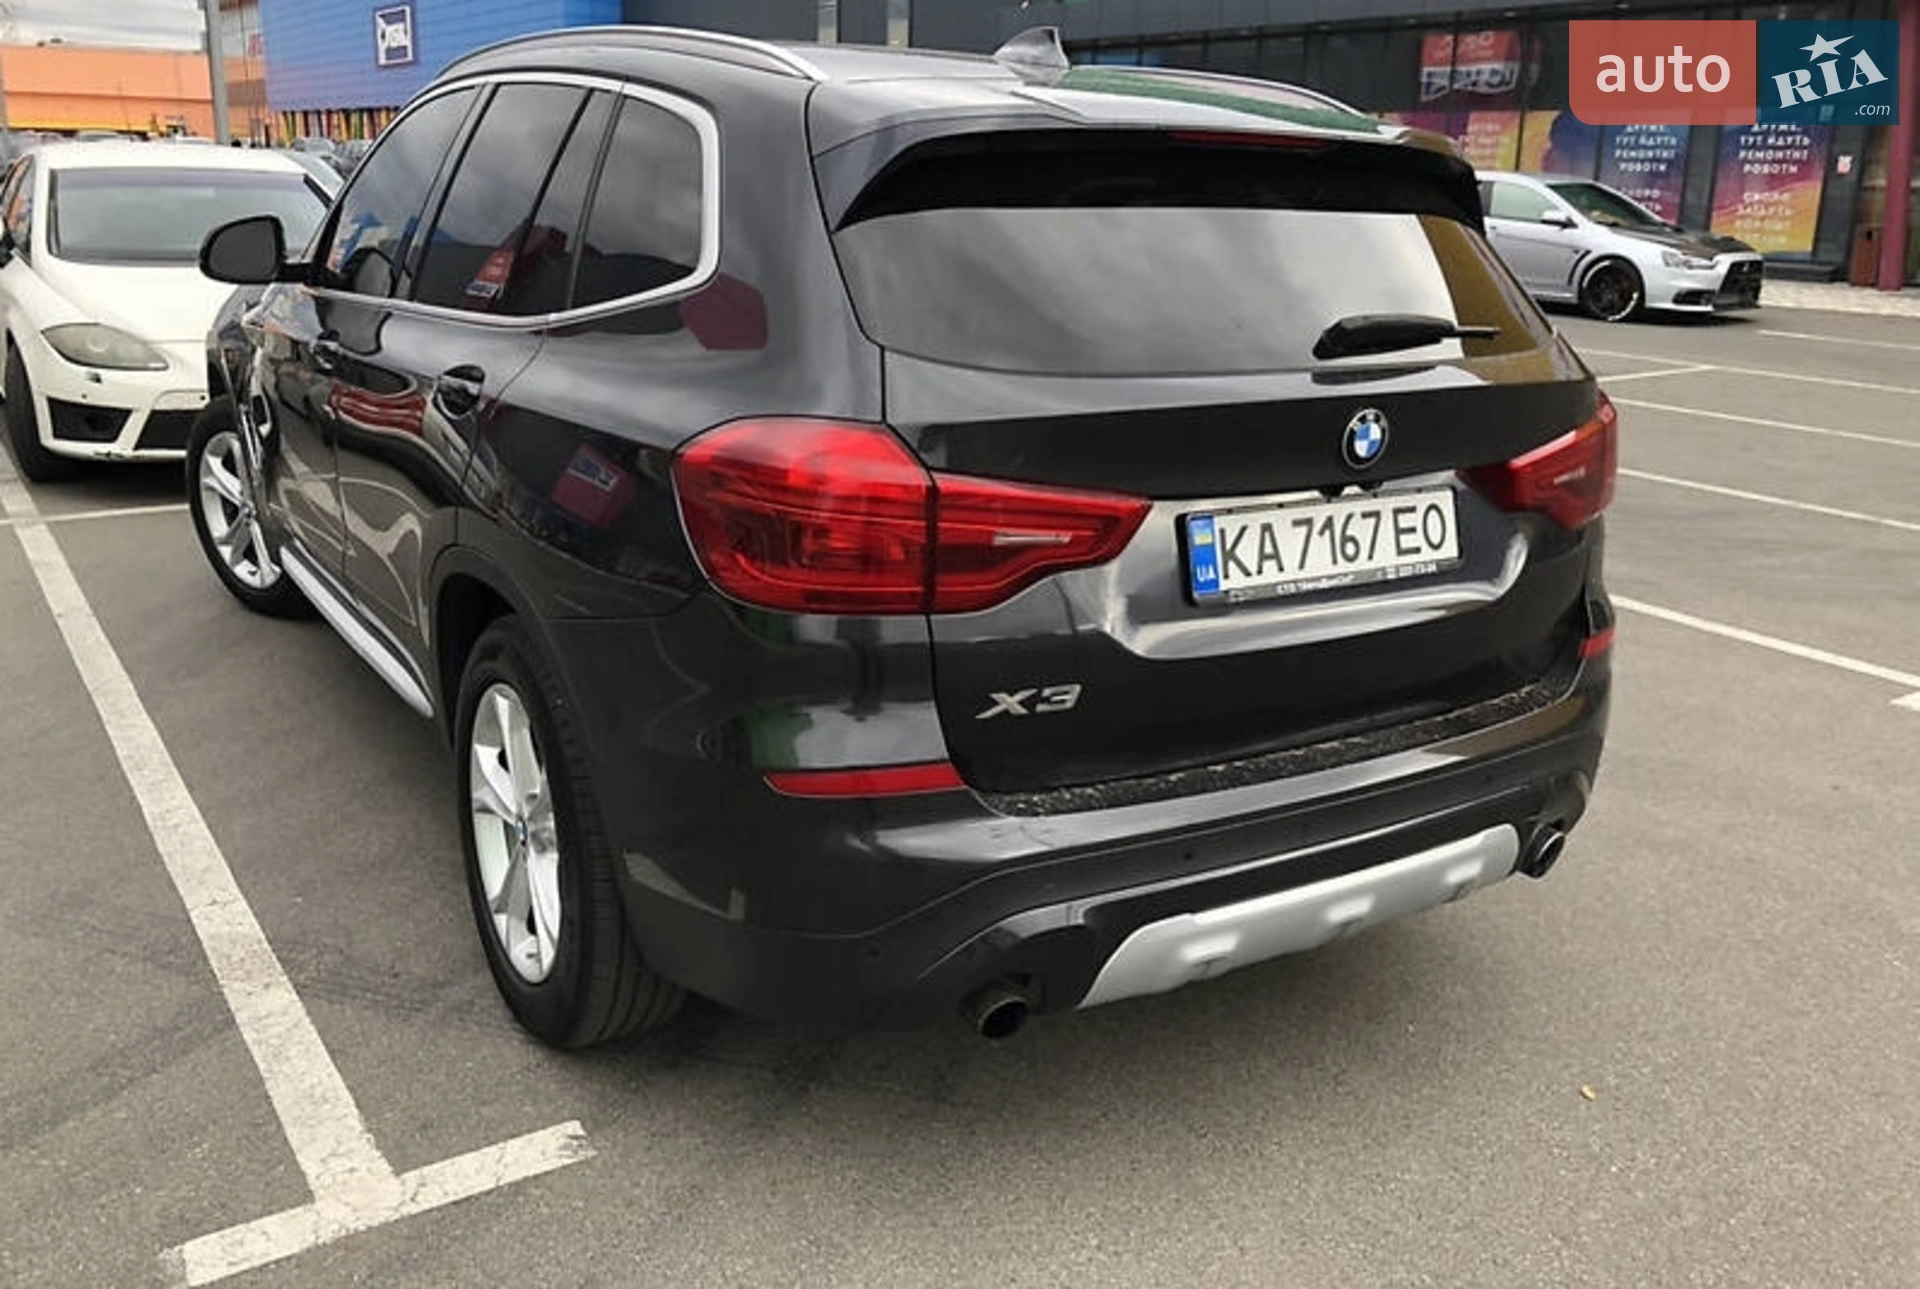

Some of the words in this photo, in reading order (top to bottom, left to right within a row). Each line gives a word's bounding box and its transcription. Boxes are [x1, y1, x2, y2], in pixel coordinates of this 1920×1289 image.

[1740, 135, 1764, 146] ТУТ
[1743, 162, 1799, 174] РОБОТИ
[1219, 522, 1285, 580] KA
[1291, 510, 1382, 571] 7167
[1392, 503, 1447, 557] EO
[1197, 566, 1217, 582] UA
[975, 684, 1082, 719] X3
